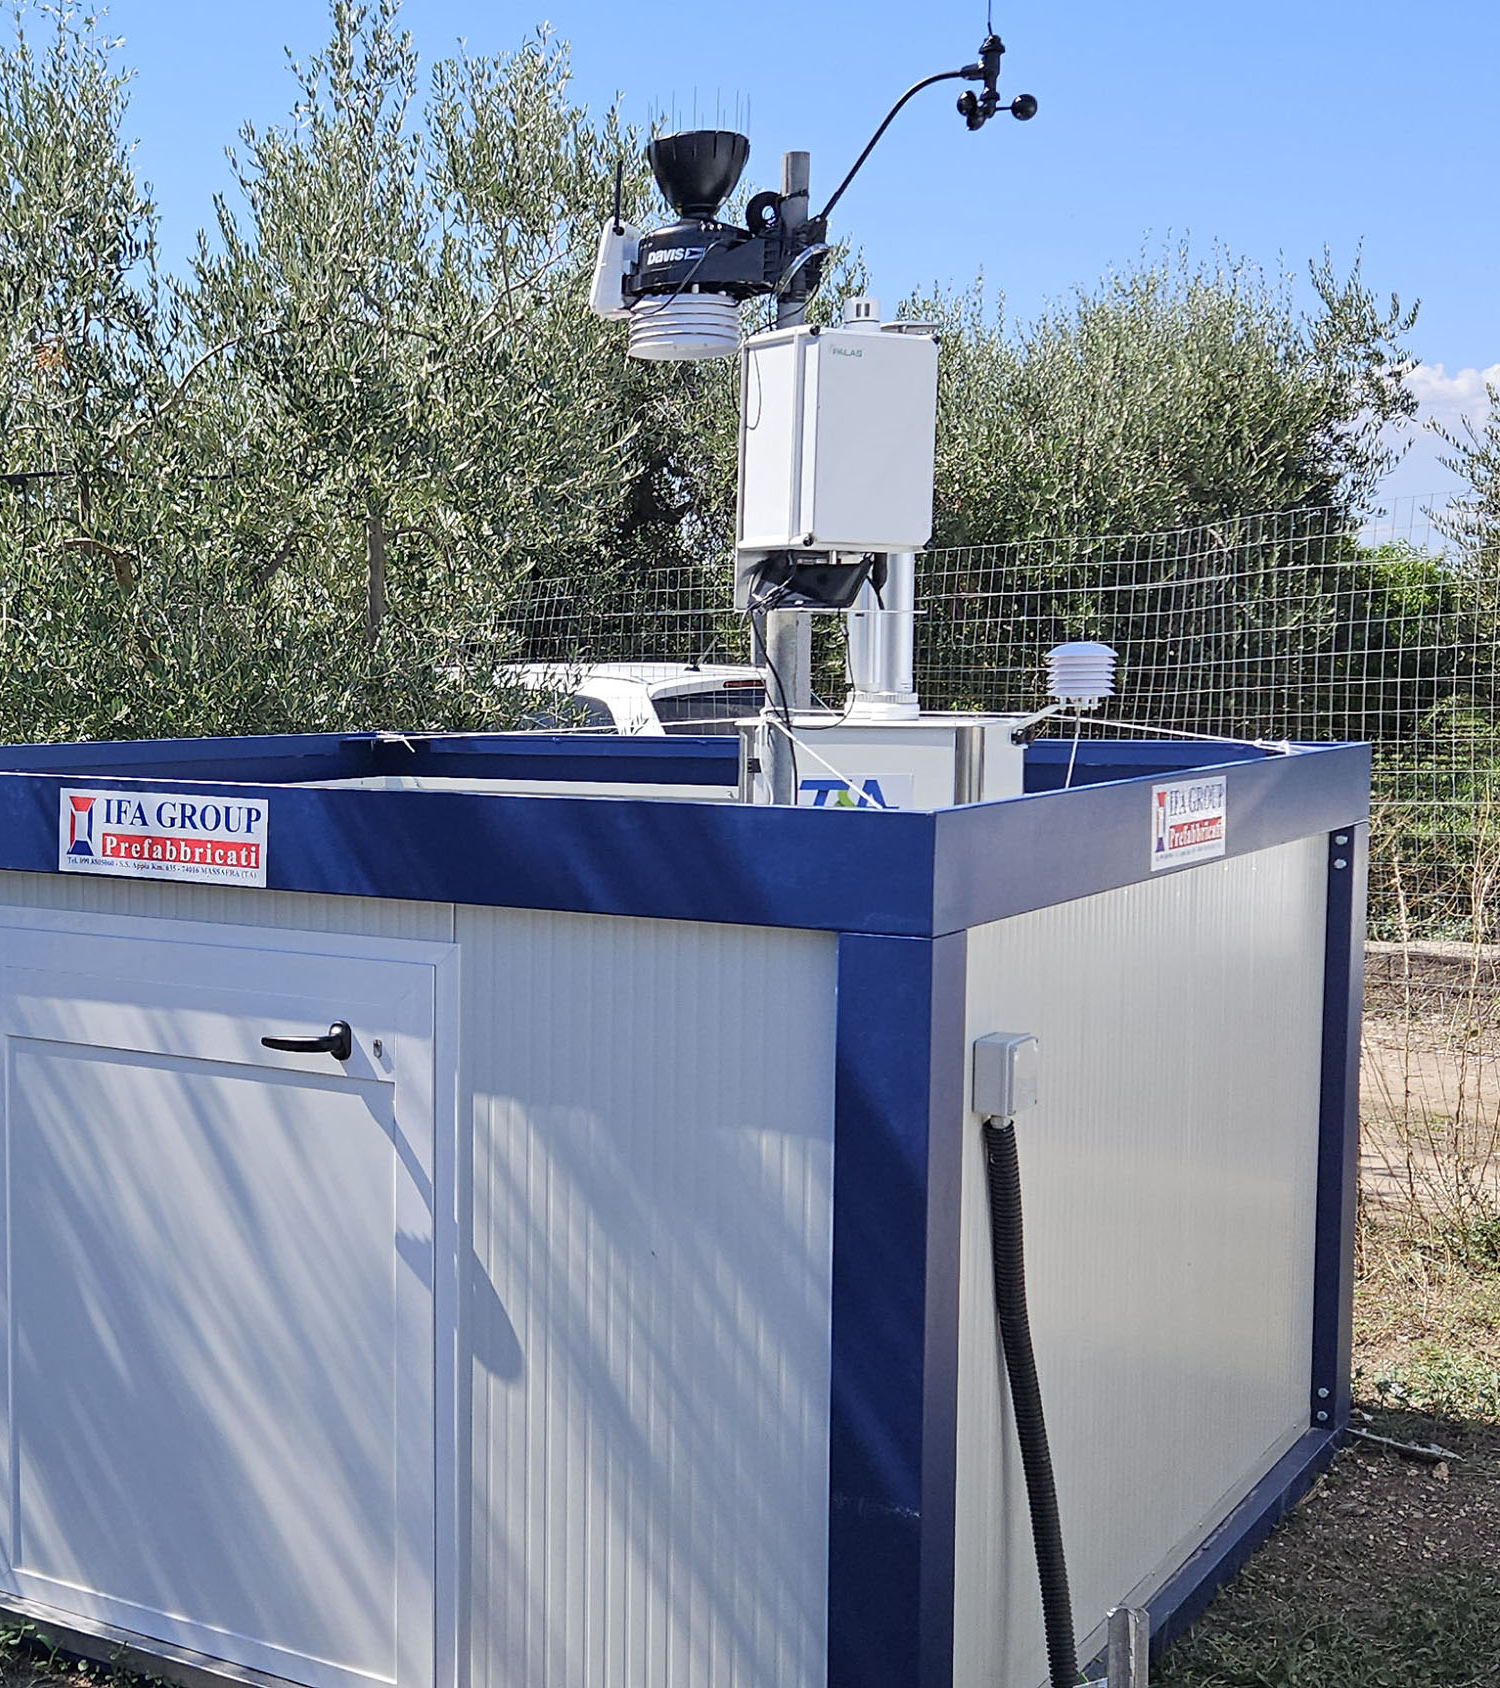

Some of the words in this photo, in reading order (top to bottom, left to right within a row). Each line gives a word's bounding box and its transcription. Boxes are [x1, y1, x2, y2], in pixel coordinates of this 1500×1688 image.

[103, 798, 149, 827] IFA
[156, 801, 261, 834] GROUP
[104, 835, 257, 867] Prefabbricati
